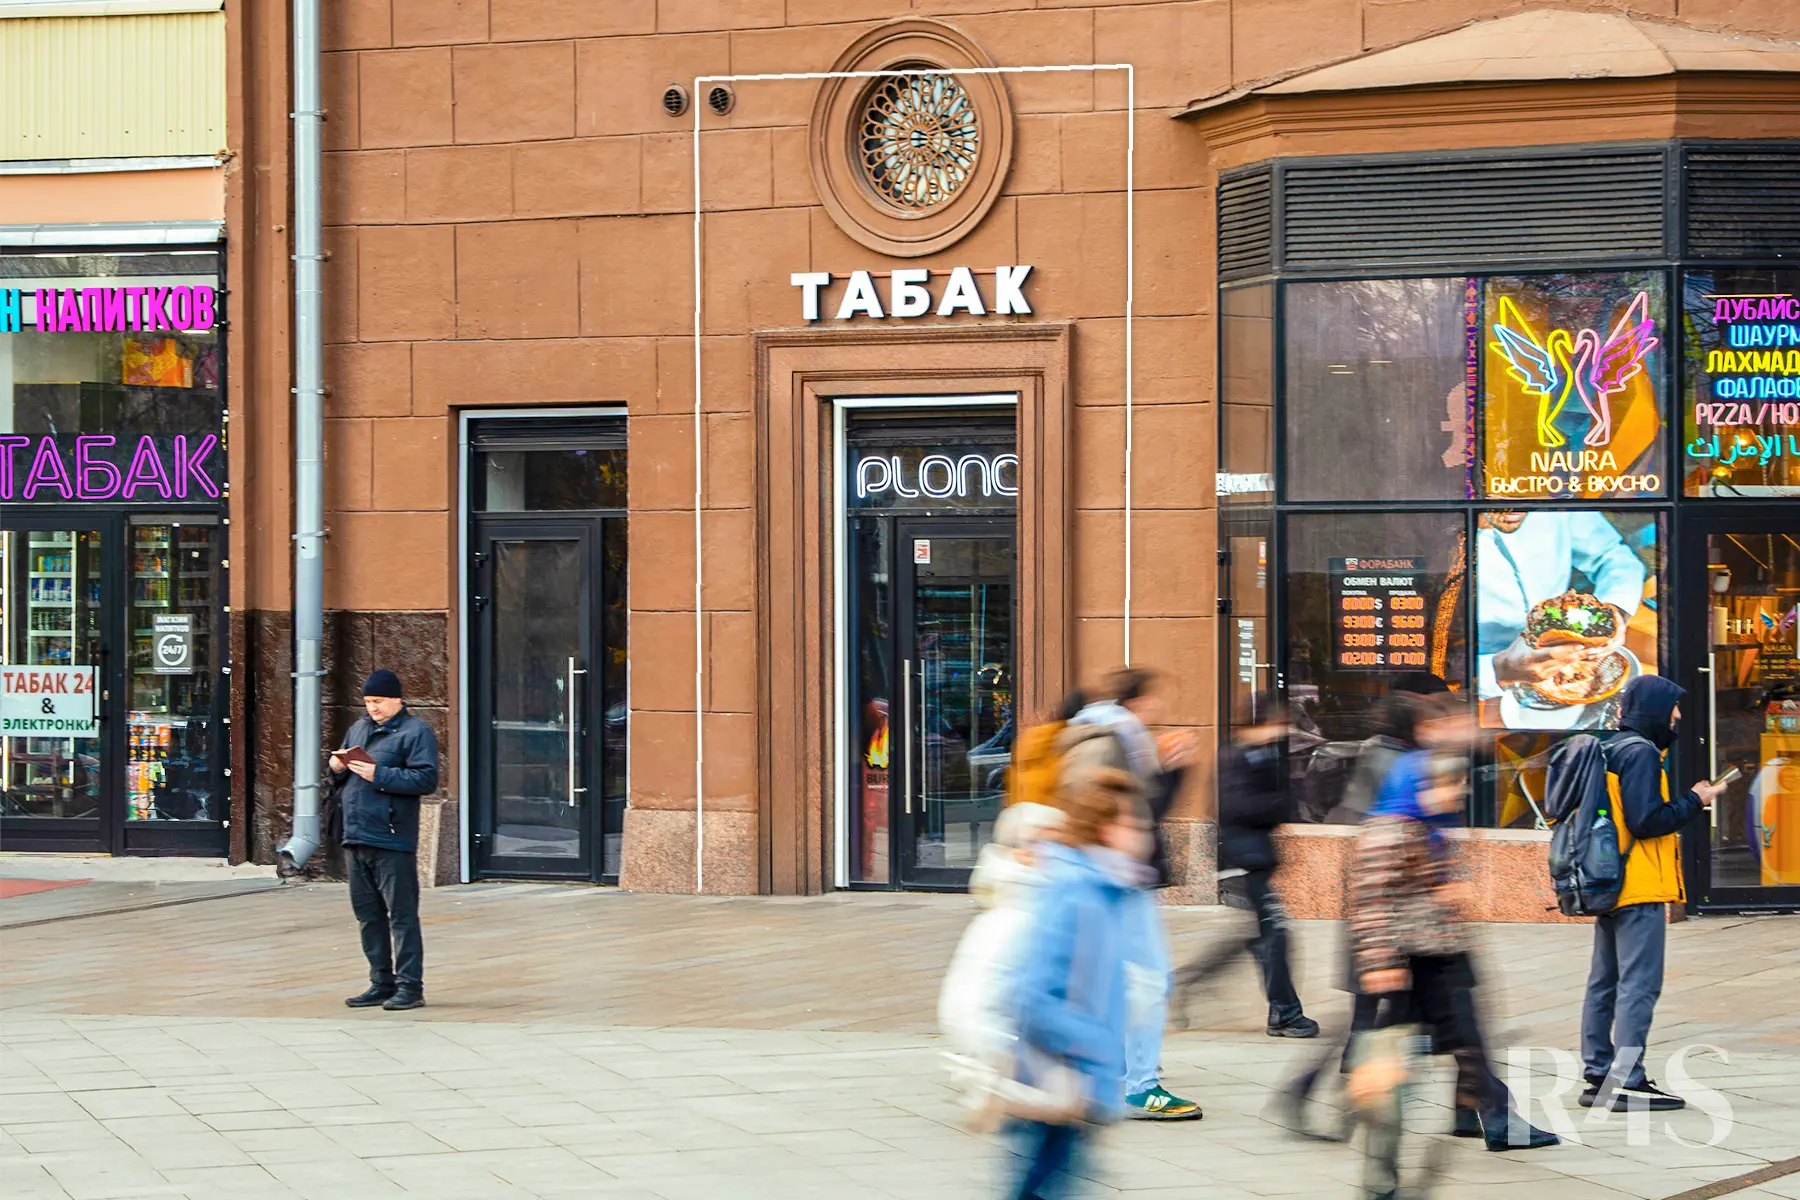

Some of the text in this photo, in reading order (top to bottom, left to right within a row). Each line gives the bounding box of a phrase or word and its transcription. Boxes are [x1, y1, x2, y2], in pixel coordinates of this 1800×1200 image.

[790, 265, 1034, 320] ТАБАК
[35, 285, 216, 332] НАПИТКОВ
[1713, 294, 1800, 323] ДУБАЙС
[1730, 324, 1800, 347] ШАУРМ
[1705, 350, 1800, 376] ЛАХМАД
[1695, 402, 1752, 425] PIZZA
[0, 434, 219, 499] ТАБАК
[1531, 450, 1617, 472] NAURA
[1491, 474, 1660, 494] БЫСТРО & ВКУСНО
[1359, 559, 1414, 569] ФОРАБАНК
[1342, 576, 1414, 587] ОБМЕН ВАЛЮТ
[3, 672, 68, 694] ТАБАК
[41, 697, 56, 715] &
